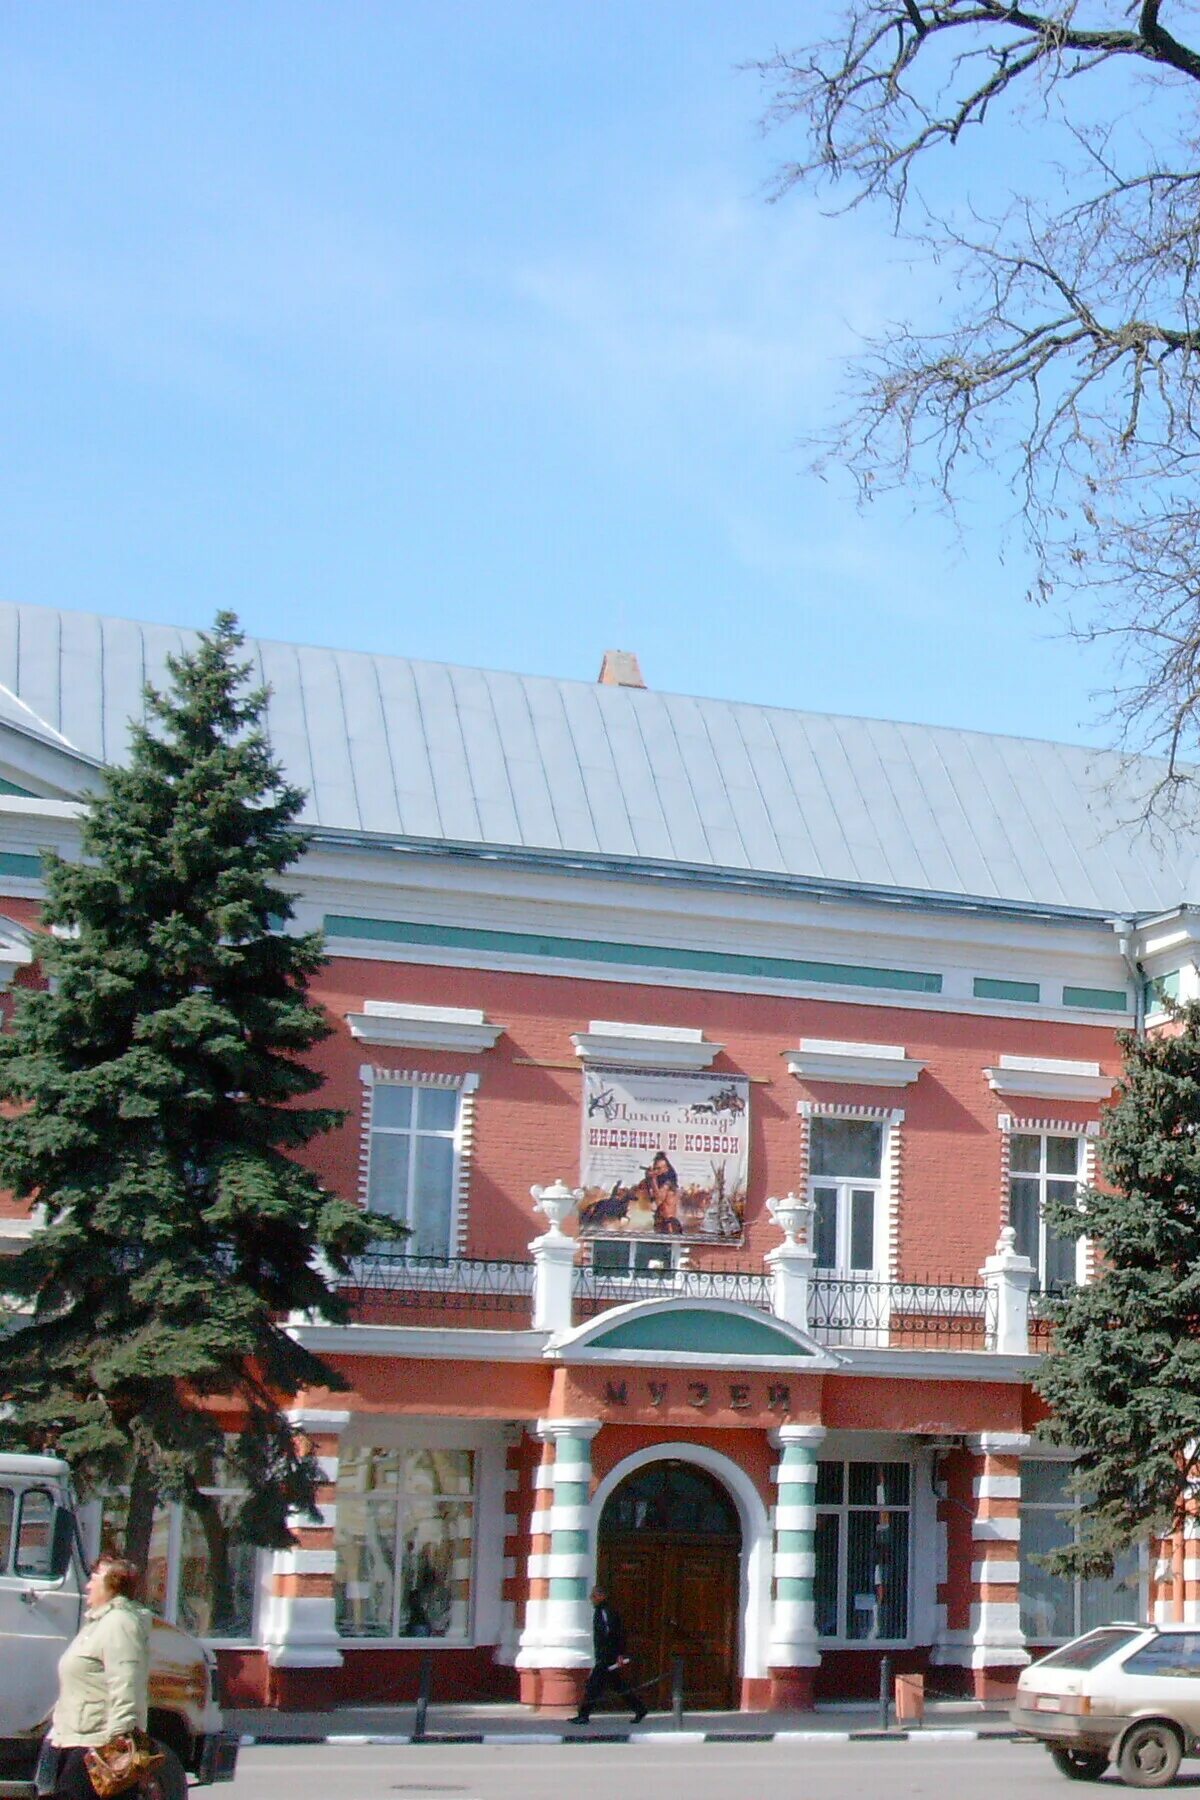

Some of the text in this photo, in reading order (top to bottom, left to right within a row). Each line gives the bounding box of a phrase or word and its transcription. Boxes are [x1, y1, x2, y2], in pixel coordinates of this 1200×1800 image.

[589, 1128, 739, 1154] ИНДЕЙЦЫ И КОВБОИ
[605, 1380, 791, 1410] МУЗЕЙ
